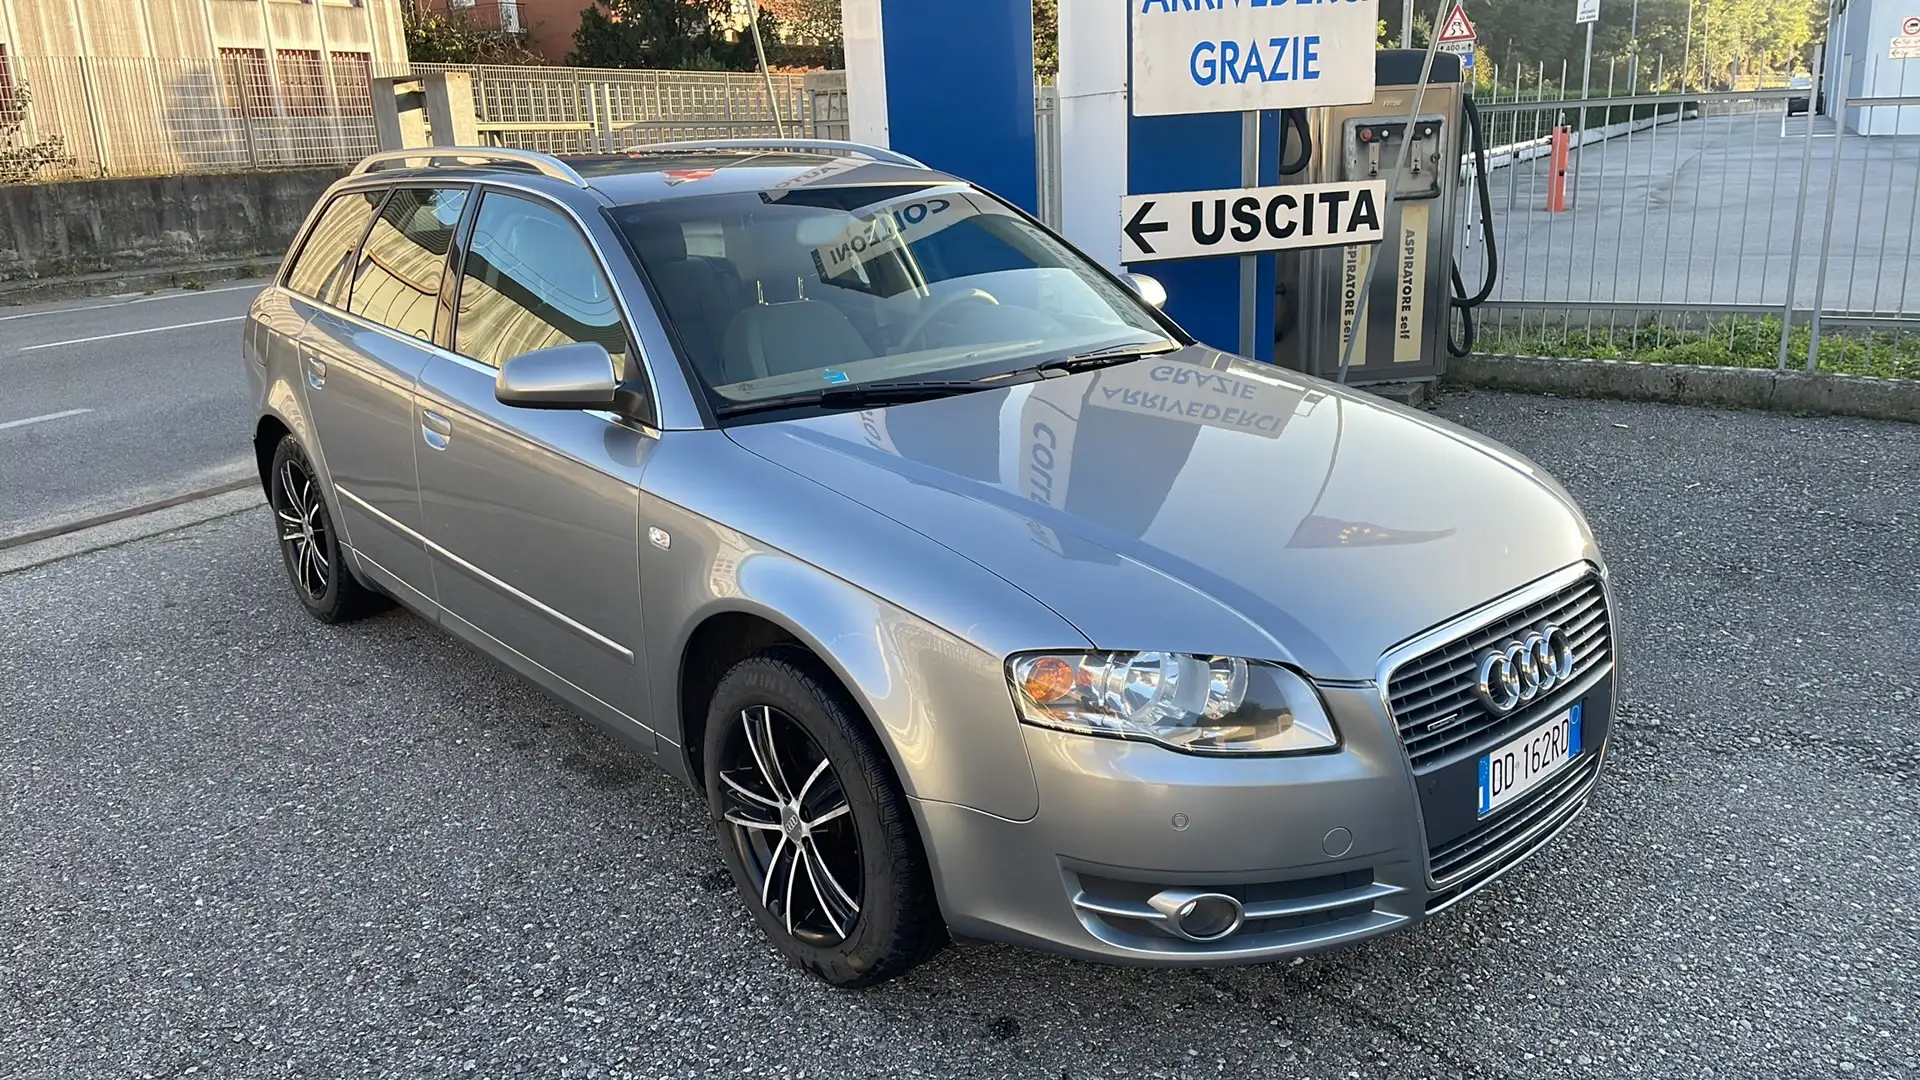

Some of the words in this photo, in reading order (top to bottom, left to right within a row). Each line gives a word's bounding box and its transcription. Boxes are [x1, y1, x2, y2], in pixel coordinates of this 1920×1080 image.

[1190, 35, 1321, 87] GRAZIE
[1191, 188, 1380, 246] USCITA
[1343, 244, 1357, 316] SPIRATORE
[1401, 229, 1415, 312] ASPIRATORE
[1400, 315, 1410, 340] self
[1492, 752, 1515, 797] DD
[1523, 718, 1569, 779] 162RD
